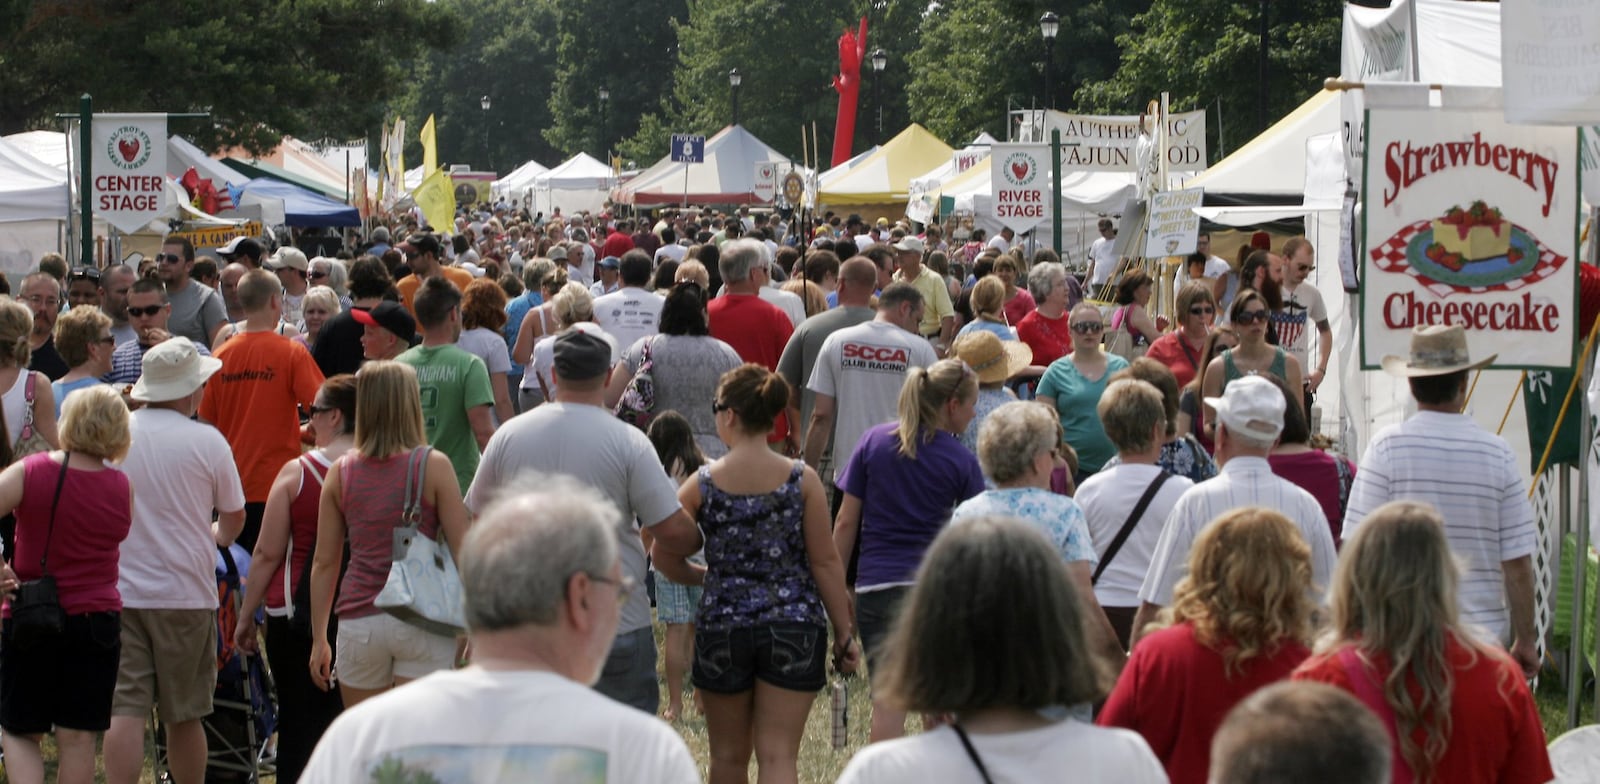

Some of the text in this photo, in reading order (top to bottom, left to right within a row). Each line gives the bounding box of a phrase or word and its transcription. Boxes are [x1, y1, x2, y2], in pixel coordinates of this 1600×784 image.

[1066, 118, 1187, 140] AUTHEIC
[1168, 145, 1200, 165] OD
[1384, 131, 1559, 218] Strawberry
[95, 175, 162, 192] CENTER
[99, 194, 158, 211] STAGE
[998, 190, 1042, 202] RIVER
[997, 204, 1044, 217] STAGE
[201, 232, 207, 245] A
[1383, 289, 1560, 333] Cheesecake
[843, 343, 907, 364] SCCA
[842, 359, 906, 372] CLUB RACING
